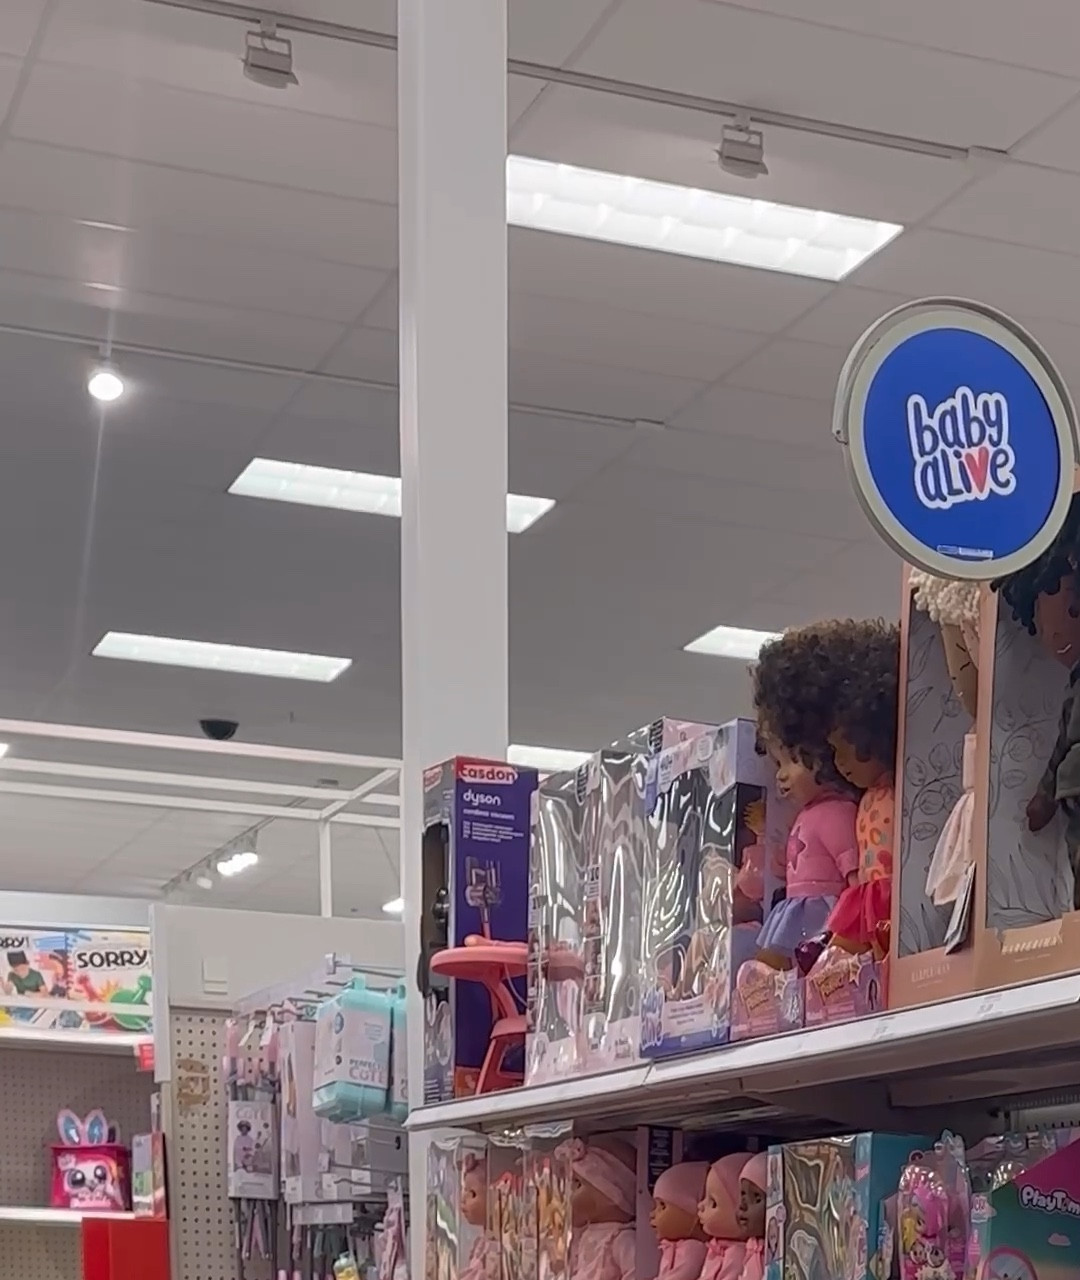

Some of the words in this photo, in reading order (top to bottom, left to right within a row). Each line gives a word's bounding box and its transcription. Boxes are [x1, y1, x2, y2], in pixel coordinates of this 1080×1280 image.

[911, 389, 1006, 459] baby
[919, 447, 1012, 502] alive
[459, 765, 516, 782] casdon
[462, 788, 502, 806] dyson
